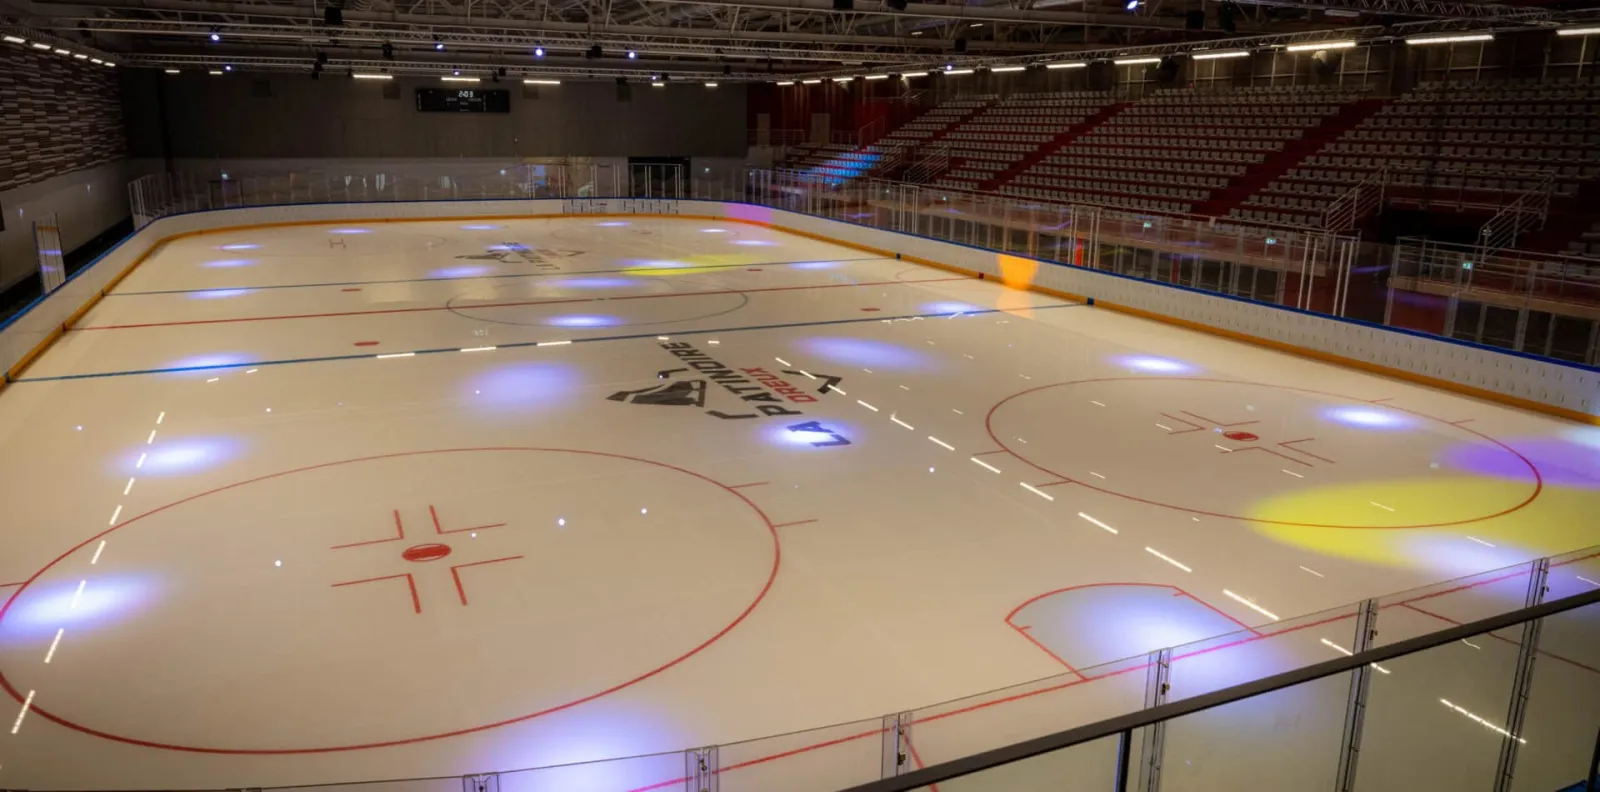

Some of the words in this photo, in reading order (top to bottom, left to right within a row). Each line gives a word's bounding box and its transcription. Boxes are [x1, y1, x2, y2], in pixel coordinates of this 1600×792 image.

[659, 341, 803, 417] PATINOIRE
[739, 367, 819, 403] DREUX
[786, 420, 852, 447] LA
